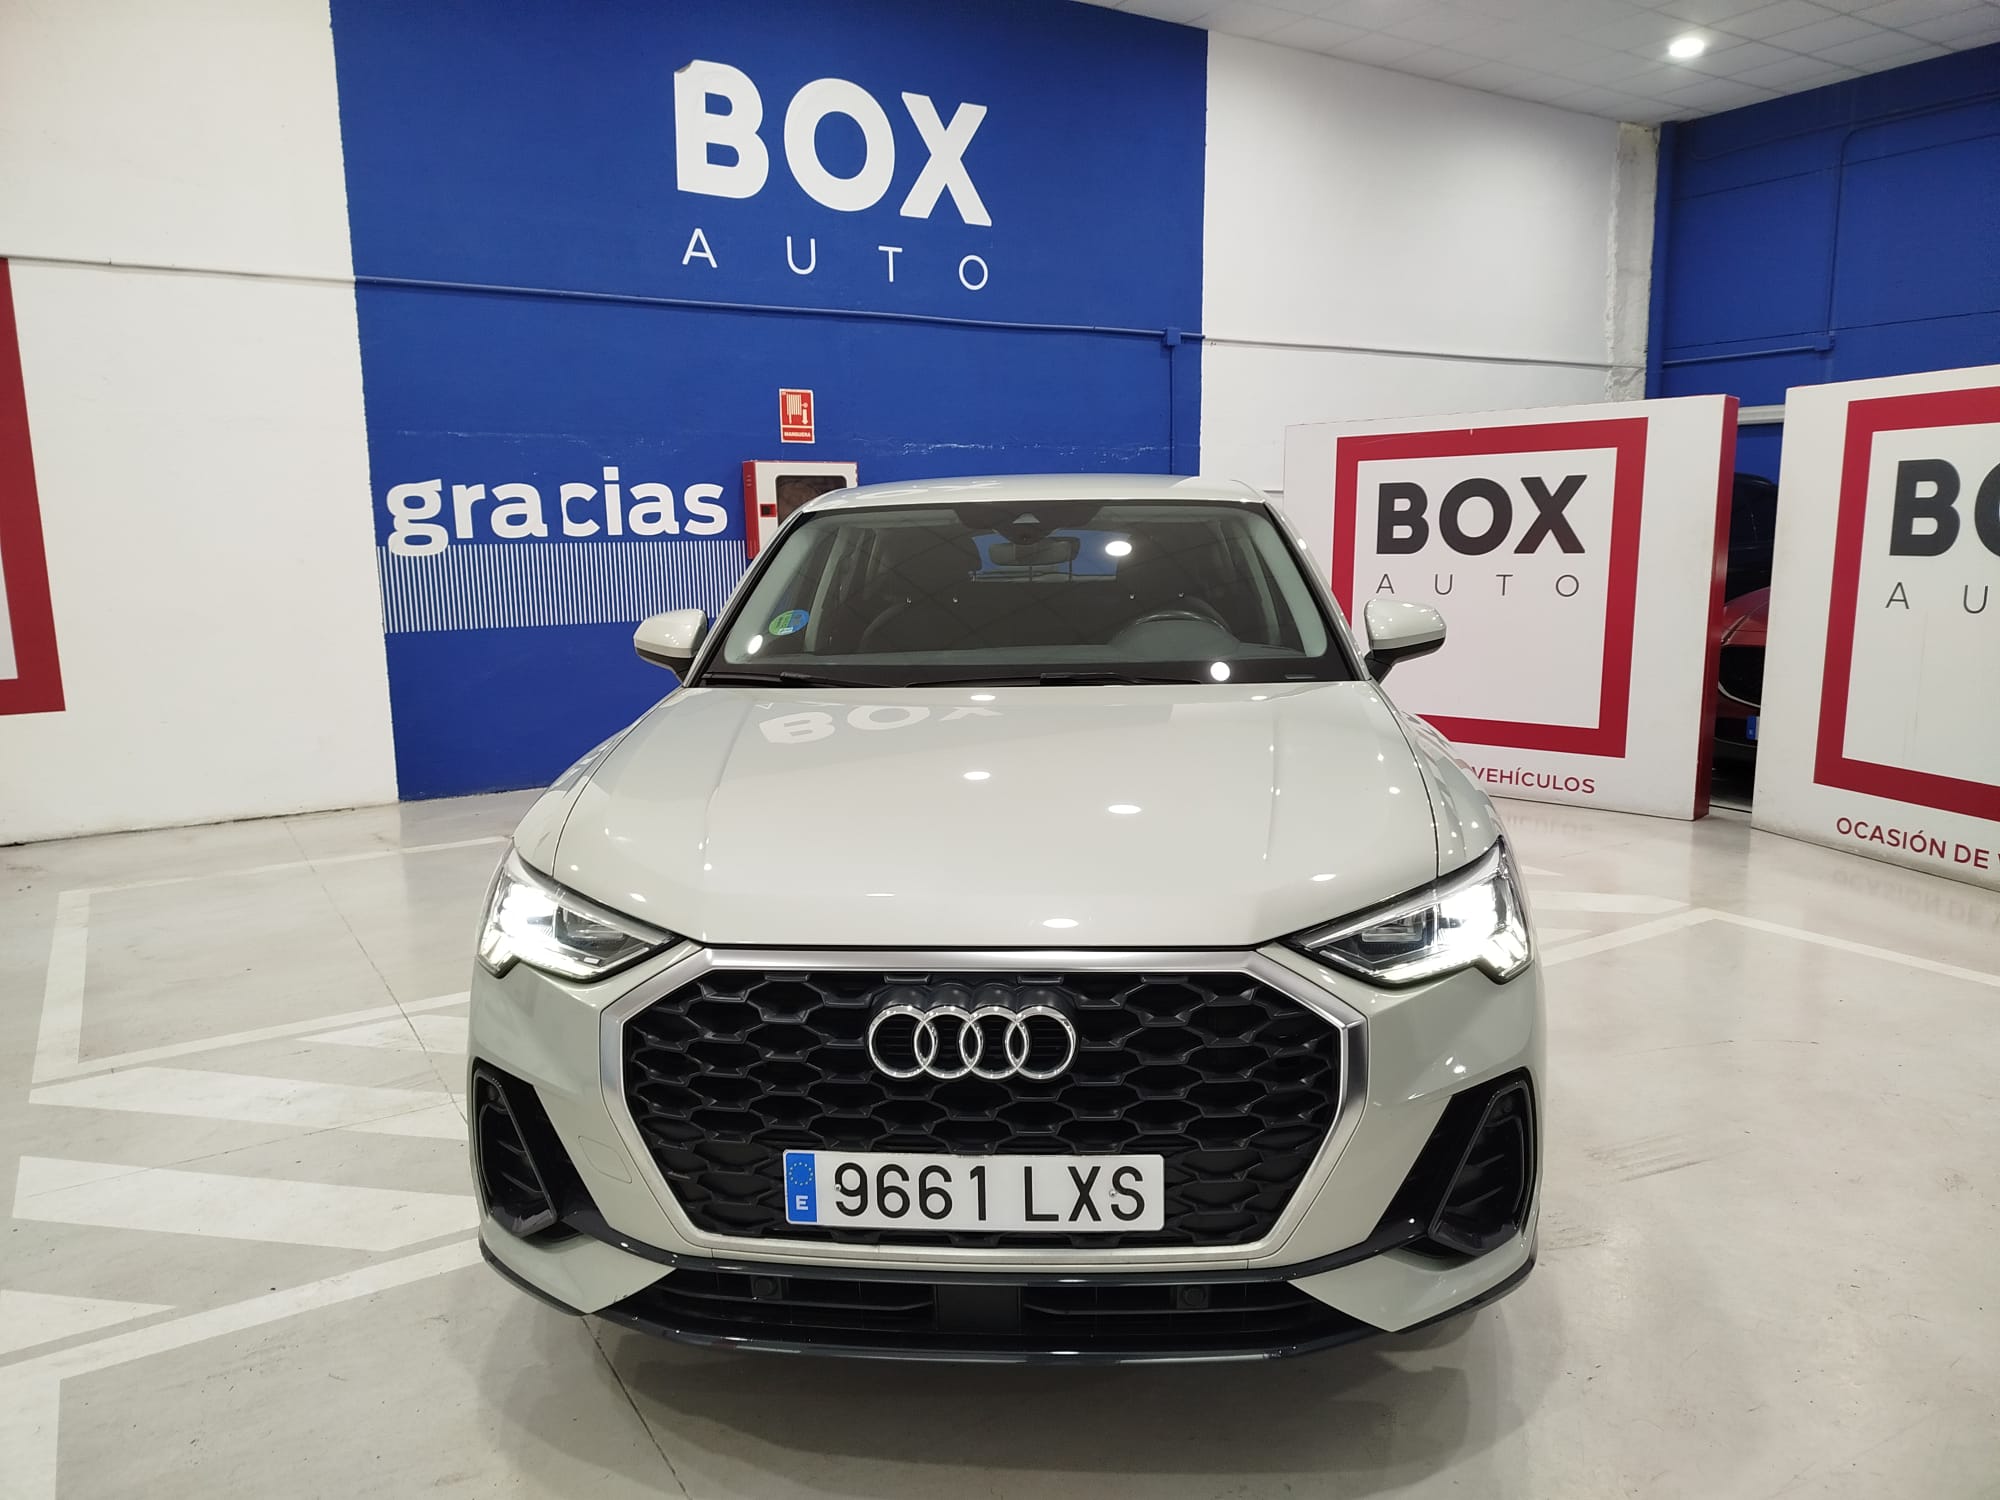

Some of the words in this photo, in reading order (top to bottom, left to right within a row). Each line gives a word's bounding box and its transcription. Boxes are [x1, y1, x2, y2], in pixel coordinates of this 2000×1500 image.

[674, 59, 992, 227] BOX
[682, 228, 989, 290] AUTO
[386, 466, 728, 557] gracias
[1376, 474, 1588, 556] BOX
[1889, 458, 2000, 558] B
[1376, 573, 1580, 597] AUTO
[1885, 581, 1989, 614] AU
[1471, 766, 1595, 794] VEHÍCULOS
[1836, 817, 1946, 859] OCASIÓN
[1954, 844, 1990, 869] DE
[796, 1195, 809, 1211] E
[834, 1162, 987, 1221] 9661
[1024, 1166, 1146, 1222] LXS
